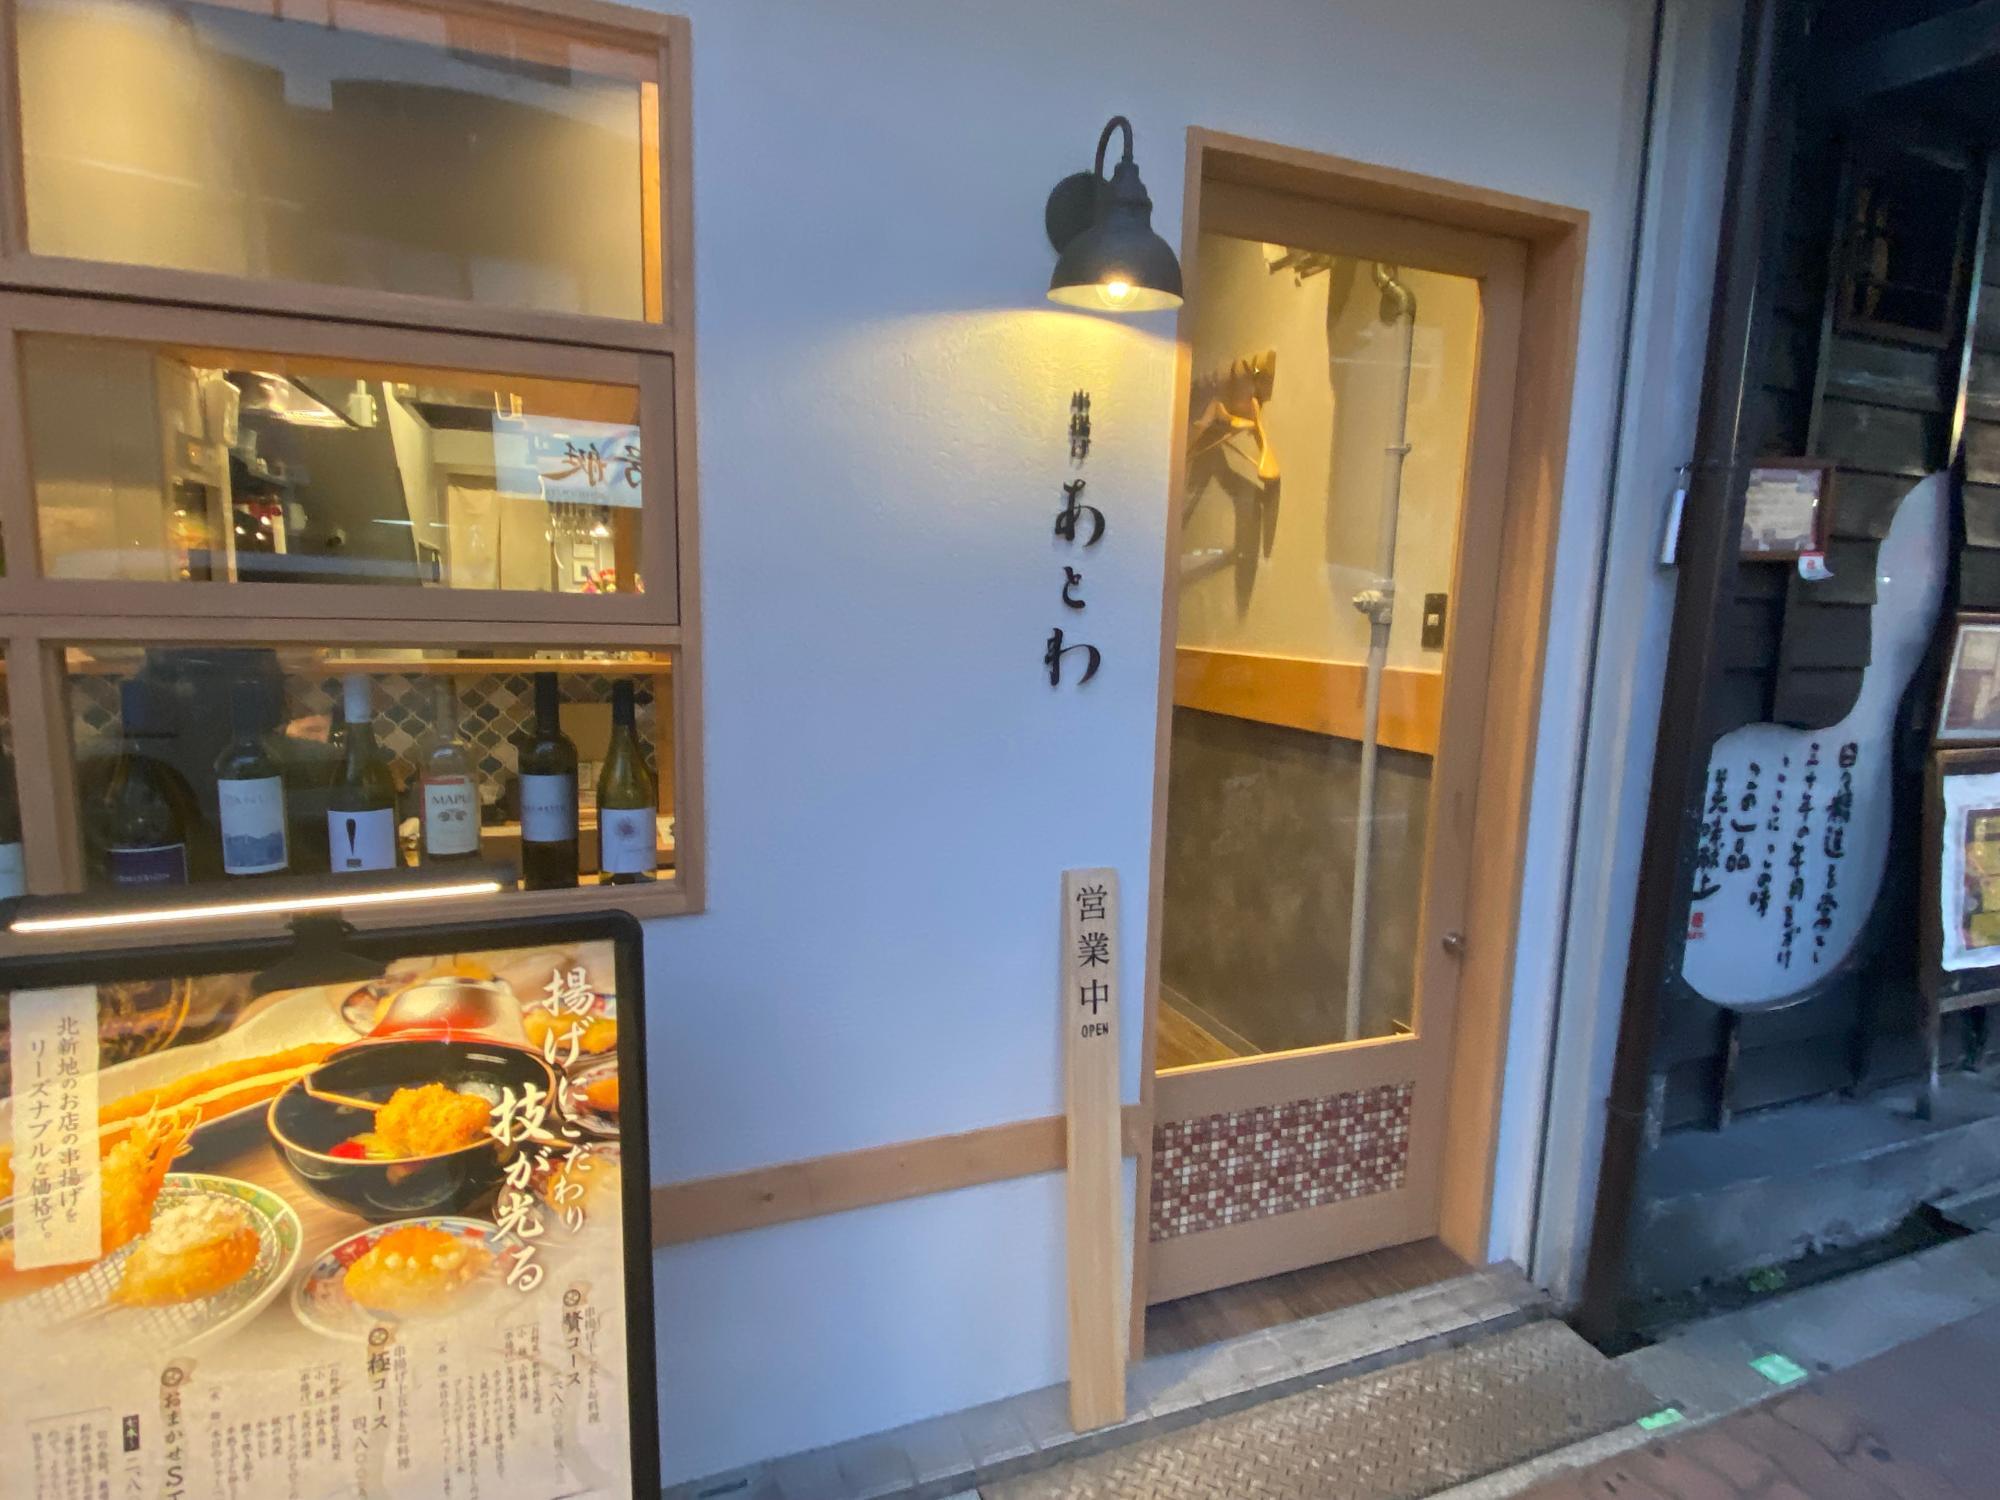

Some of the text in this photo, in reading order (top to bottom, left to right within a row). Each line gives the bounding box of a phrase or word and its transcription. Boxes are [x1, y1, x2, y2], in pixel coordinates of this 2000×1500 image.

[1076, 884, 1110, 1015] 営業中
[1081, 1023, 1110, 1038] OPEN
[57, 1016, 84, 1224] 北新地のお店の串揚げを
[542, 966, 596, 1234] 揚げにこだわり
[489, 1081, 554, 1293] 技が光る
[367, 1351, 391, 1431] 極コース
